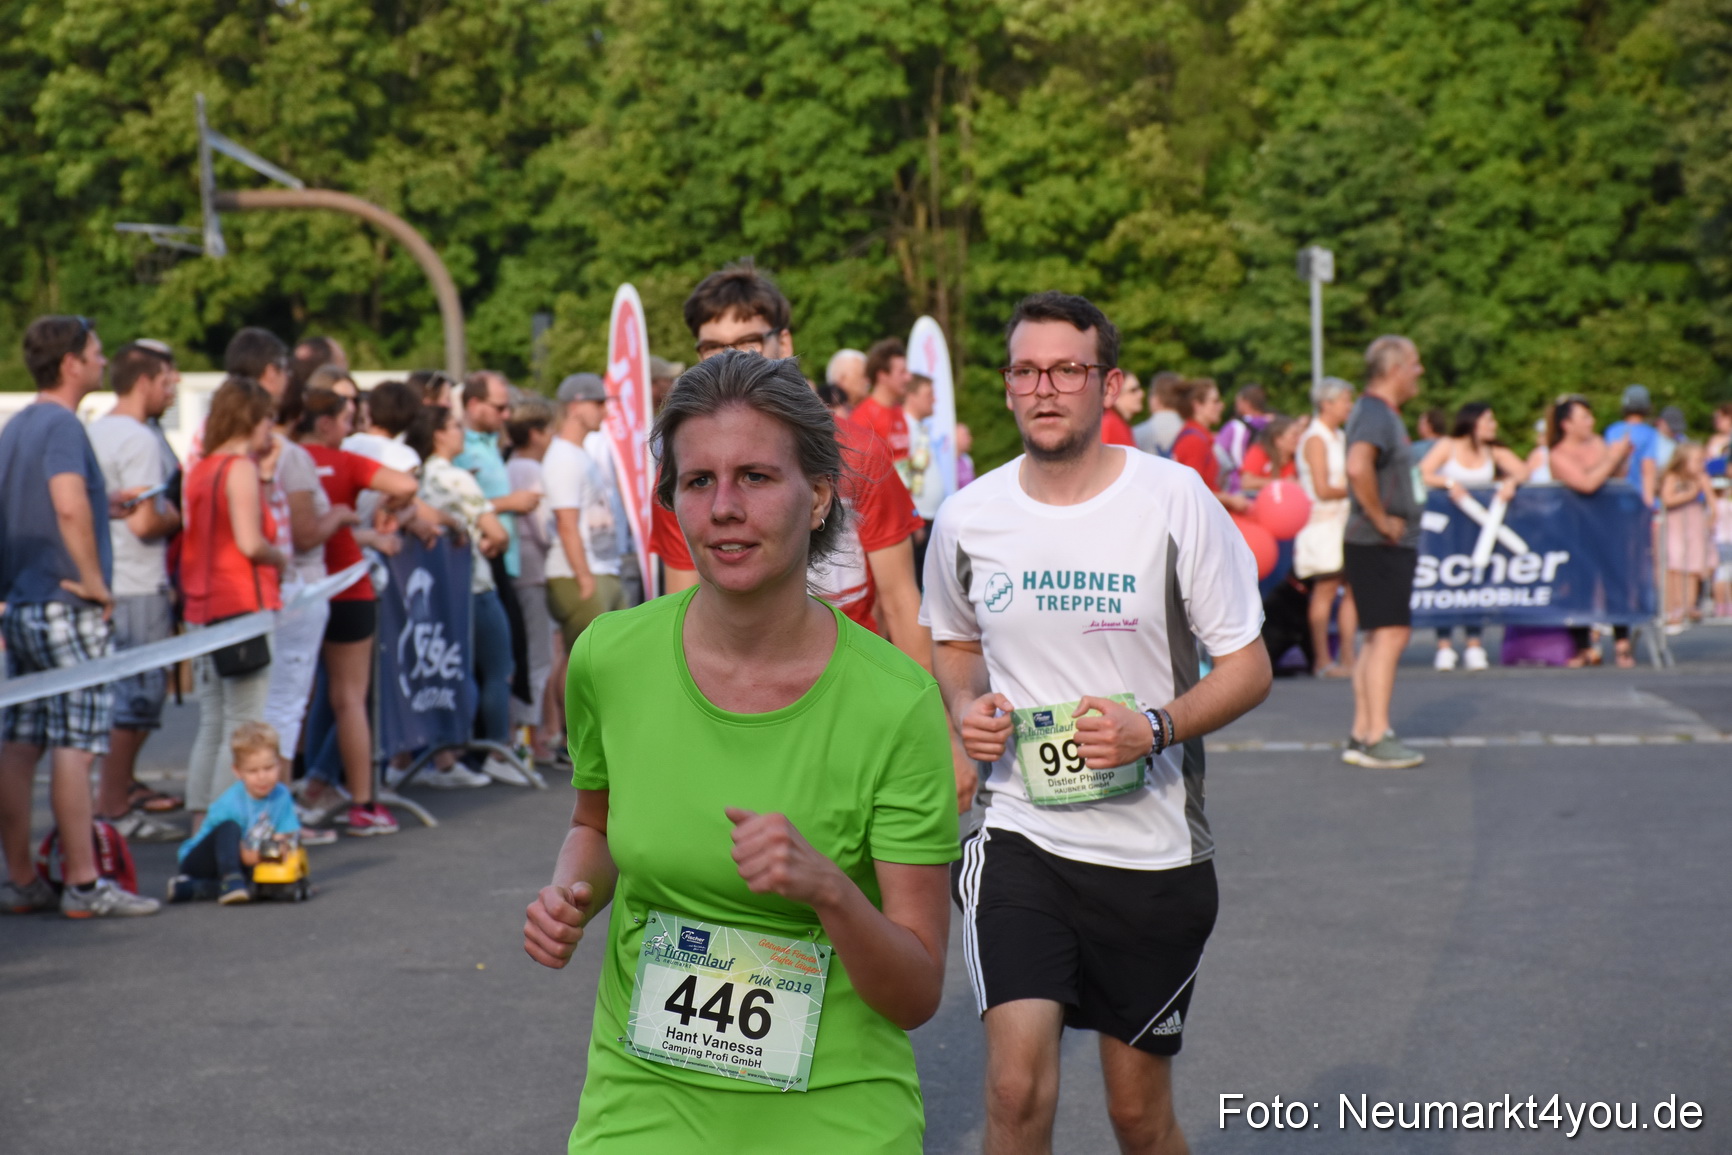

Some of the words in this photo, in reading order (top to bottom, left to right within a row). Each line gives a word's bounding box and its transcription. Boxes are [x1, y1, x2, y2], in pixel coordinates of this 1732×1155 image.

[1412, 550, 1570, 588] scher
[1023, 571, 1136, 593] HAUBNER
[1036, 595, 1122, 614] TREPPEN
[1039, 739, 1087, 777] 99
[1048, 778, 1077, 788] Distler
[1079, 770, 1115, 784] Philipp
[1054, 785, 1087, 795] HAUBNER
[1088, 781, 1111, 791] GmbH
[662, 957, 692, 969] neumarkt
[664, 944, 736, 971] firmenlauf
[758, 938, 791, 955] Gesunde
[791, 949, 818, 964] Firmen
[769, 952, 794, 966] laufen
[748, 973, 773, 987] run
[776, 978, 813, 995] 2019
[664, 974, 774, 1040] 446
[666, 1026, 698, 1044] Hant
[703, 1033, 763, 1057] Vanessa
[661, 1040, 703, 1059] Camping
[705, 1050, 728, 1063] Profi
[731, 1055, 762, 1069] GmbH
